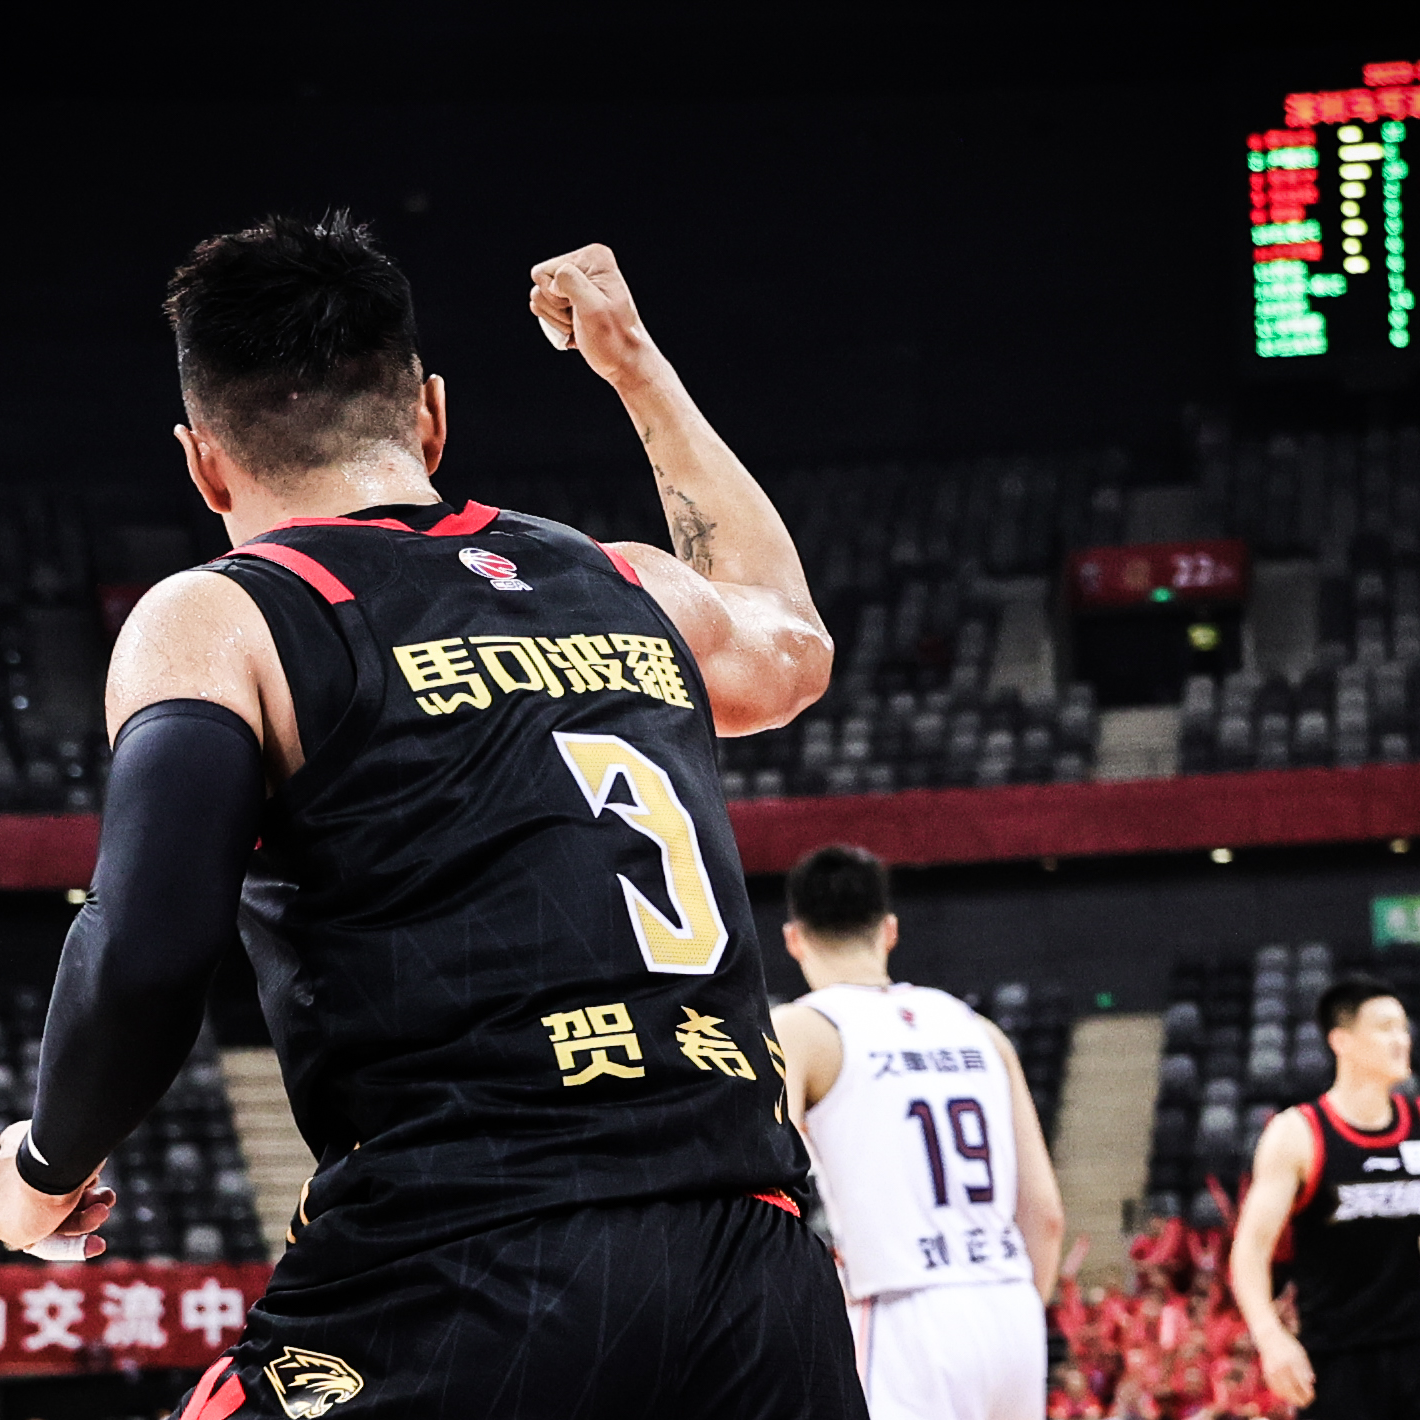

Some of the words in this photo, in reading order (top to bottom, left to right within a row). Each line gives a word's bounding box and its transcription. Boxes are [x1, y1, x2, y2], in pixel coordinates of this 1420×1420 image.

[490, 578, 534, 591] CBA
[392, 633, 694, 717] 馬可波羅
[552, 730, 729, 975] 3
[906, 1097, 994, 1207] 19
